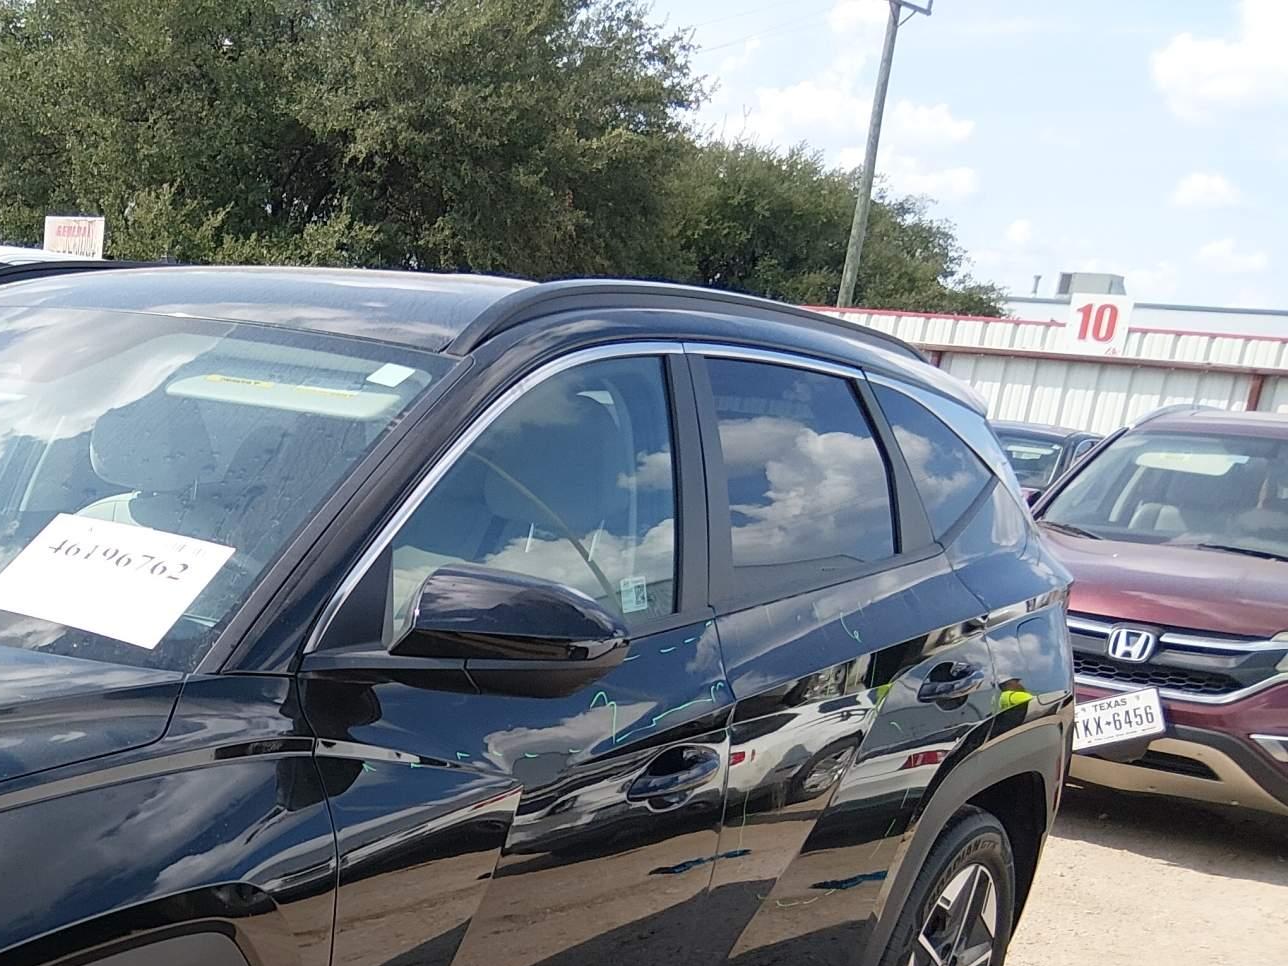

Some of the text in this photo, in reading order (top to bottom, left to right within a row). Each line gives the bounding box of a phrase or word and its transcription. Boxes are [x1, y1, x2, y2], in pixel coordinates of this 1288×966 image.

[1076, 303, 1119, 343] 10
[48, 538, 190, 582] 46196762
[1091, 697, 1128, 713] TEXAS
[1112, 704, 1155, 731] 6456
